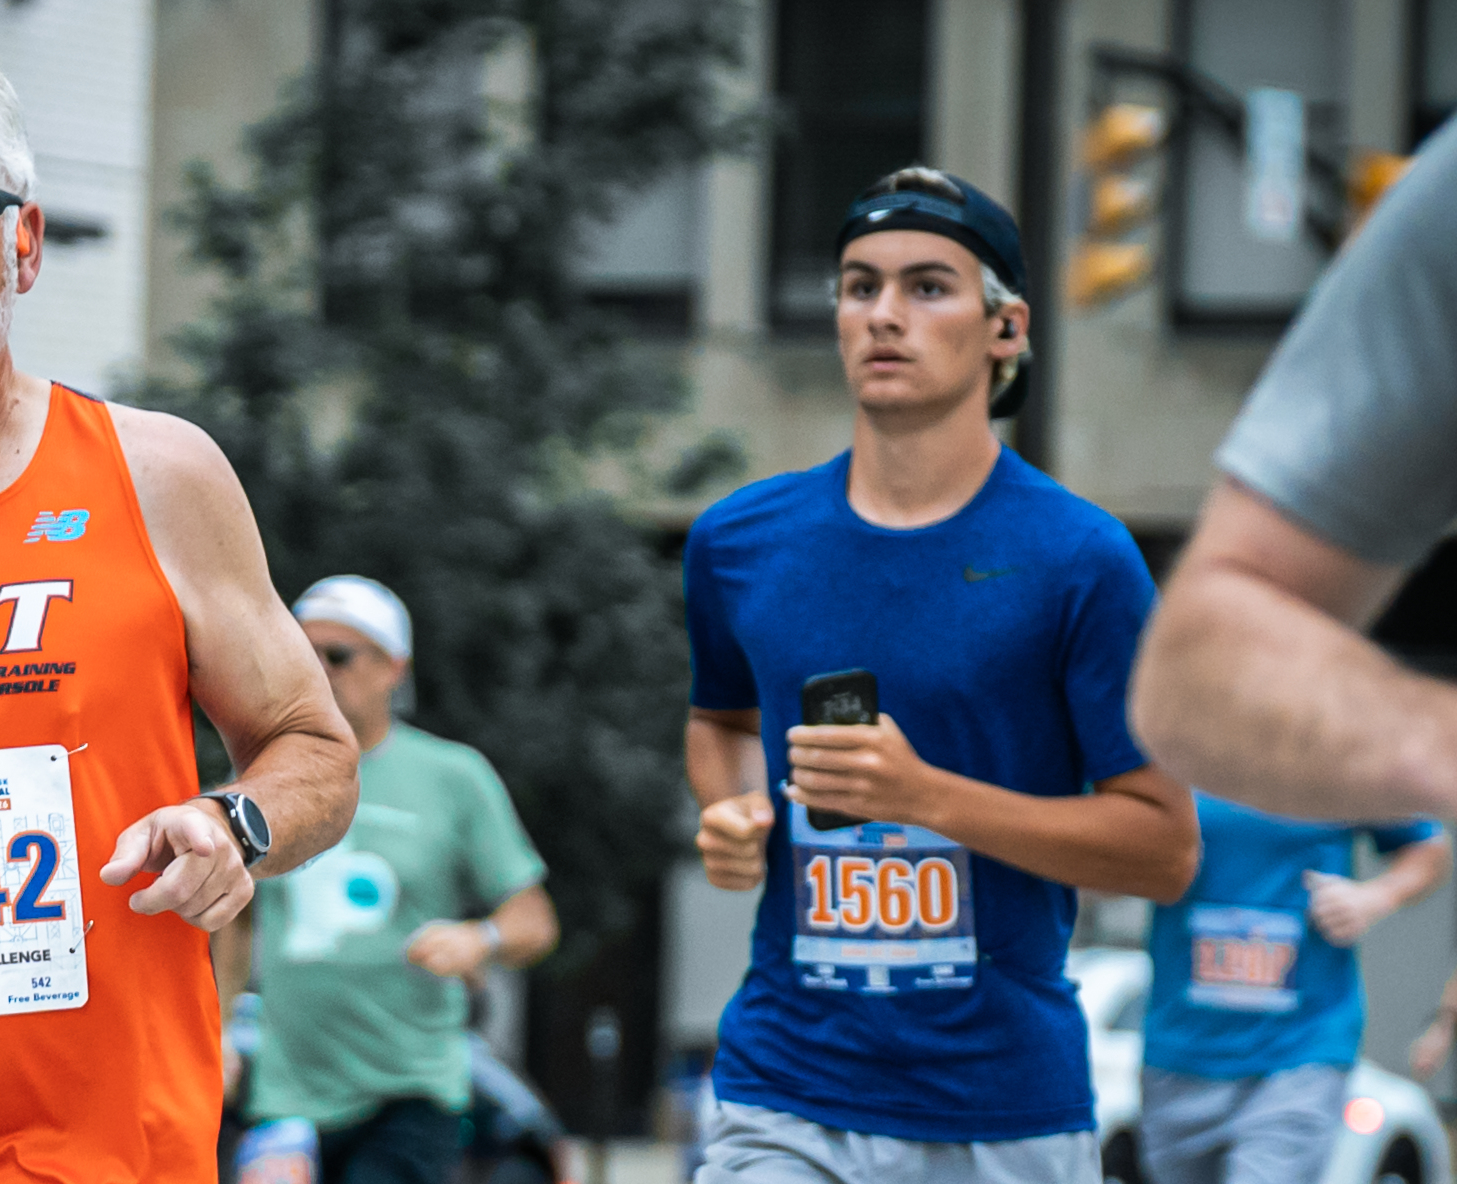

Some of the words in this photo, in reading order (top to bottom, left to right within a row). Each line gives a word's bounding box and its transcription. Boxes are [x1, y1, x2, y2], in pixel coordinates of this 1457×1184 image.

[806, 855, 958, 934] 1560
[31, 976, 52, 989] 542
[8, 994, 30, 1004] Free
[33, 991, 80, 1001] Beverage
